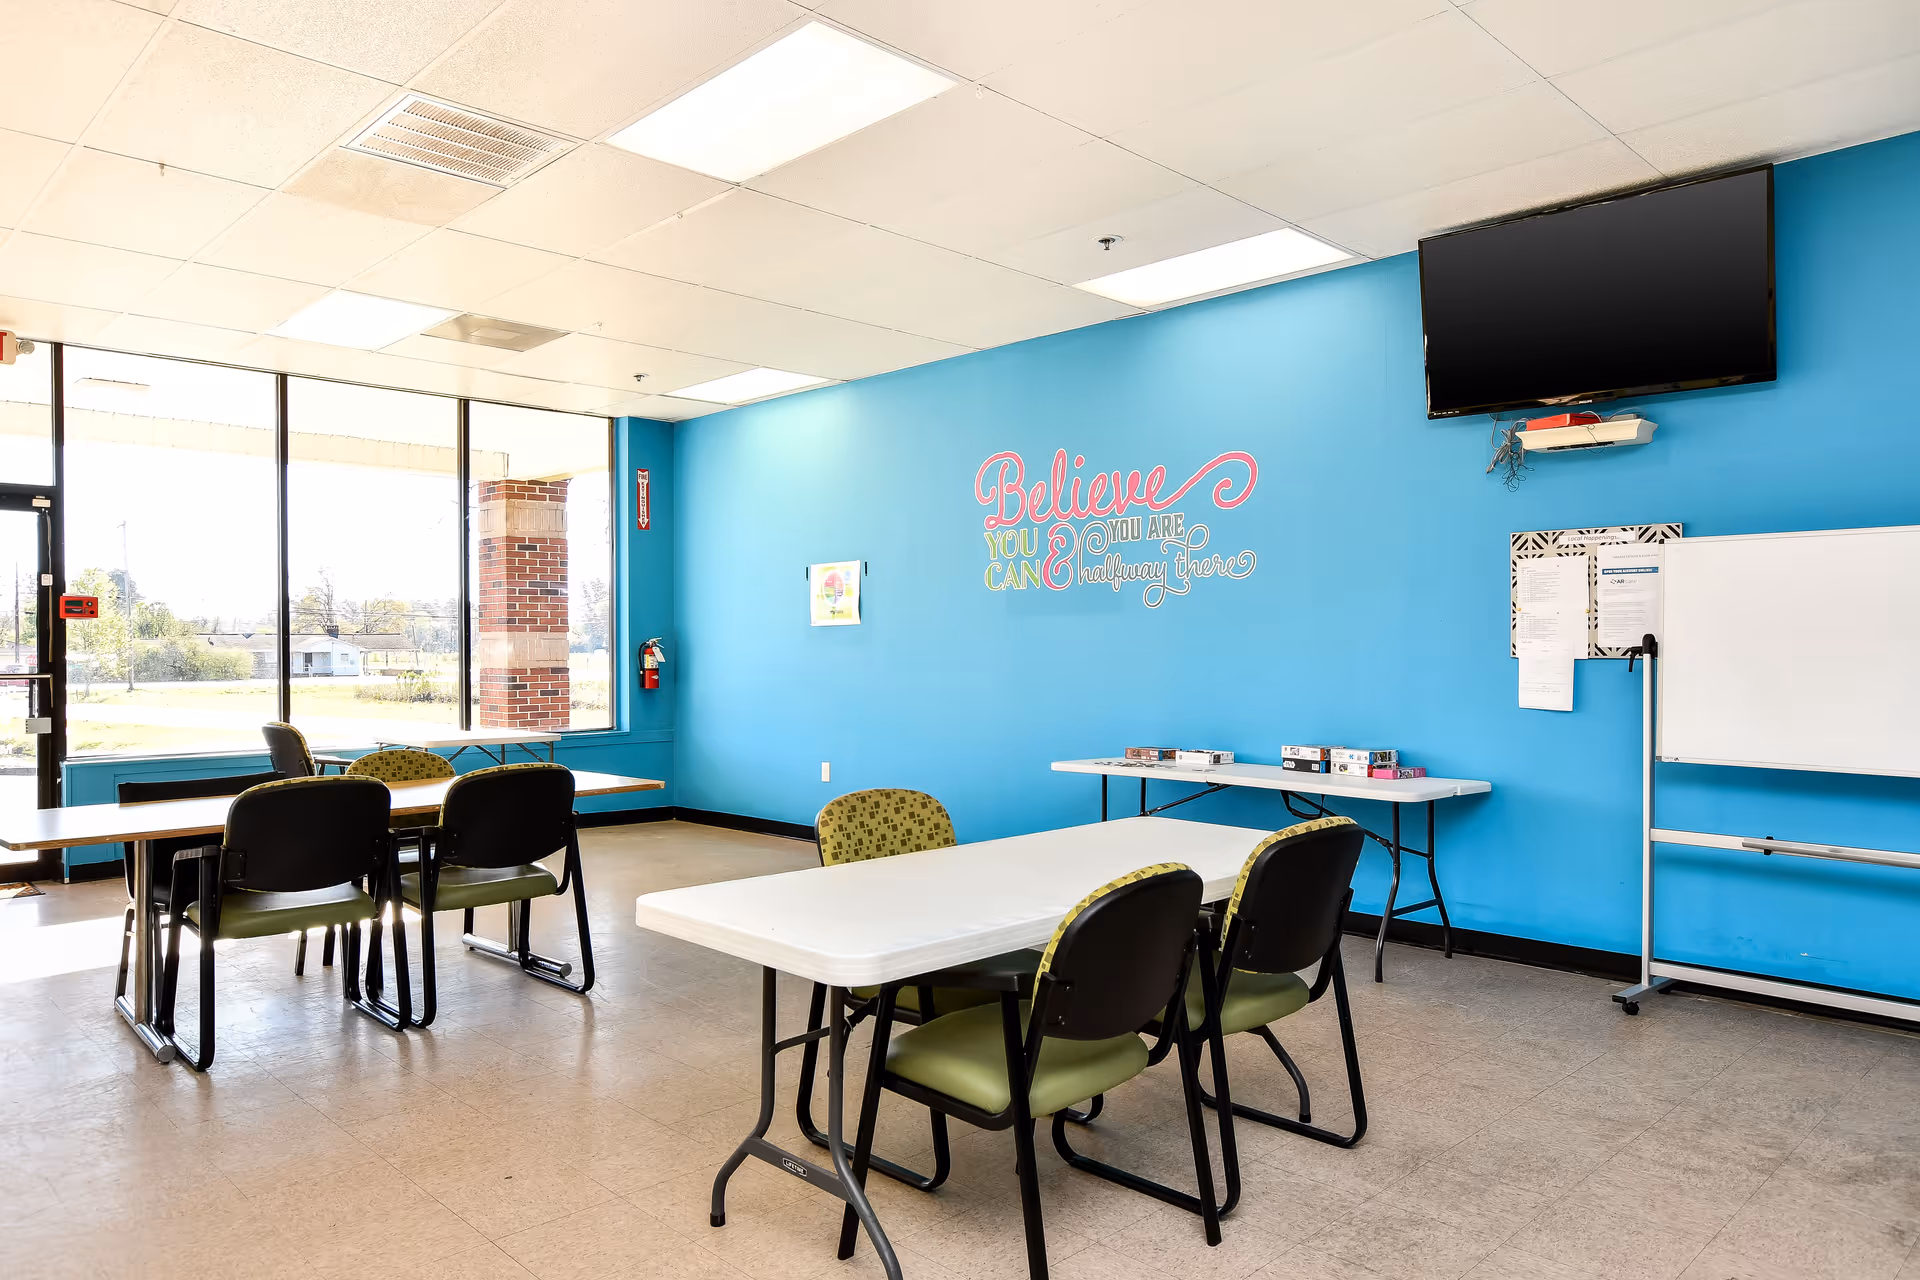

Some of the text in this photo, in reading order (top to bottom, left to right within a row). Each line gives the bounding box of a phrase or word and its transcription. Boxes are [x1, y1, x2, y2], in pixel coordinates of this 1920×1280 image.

[975, 448, 1258, 529] Believe
[984, 527, 1039, 560] YOU
[1108, 513, 1184, 543] YOU ARE
[984, 560, 1041, 590] CAN
[1043, 522, 1078, 590] &
[1078, 522, 1257, 608] halfway there
